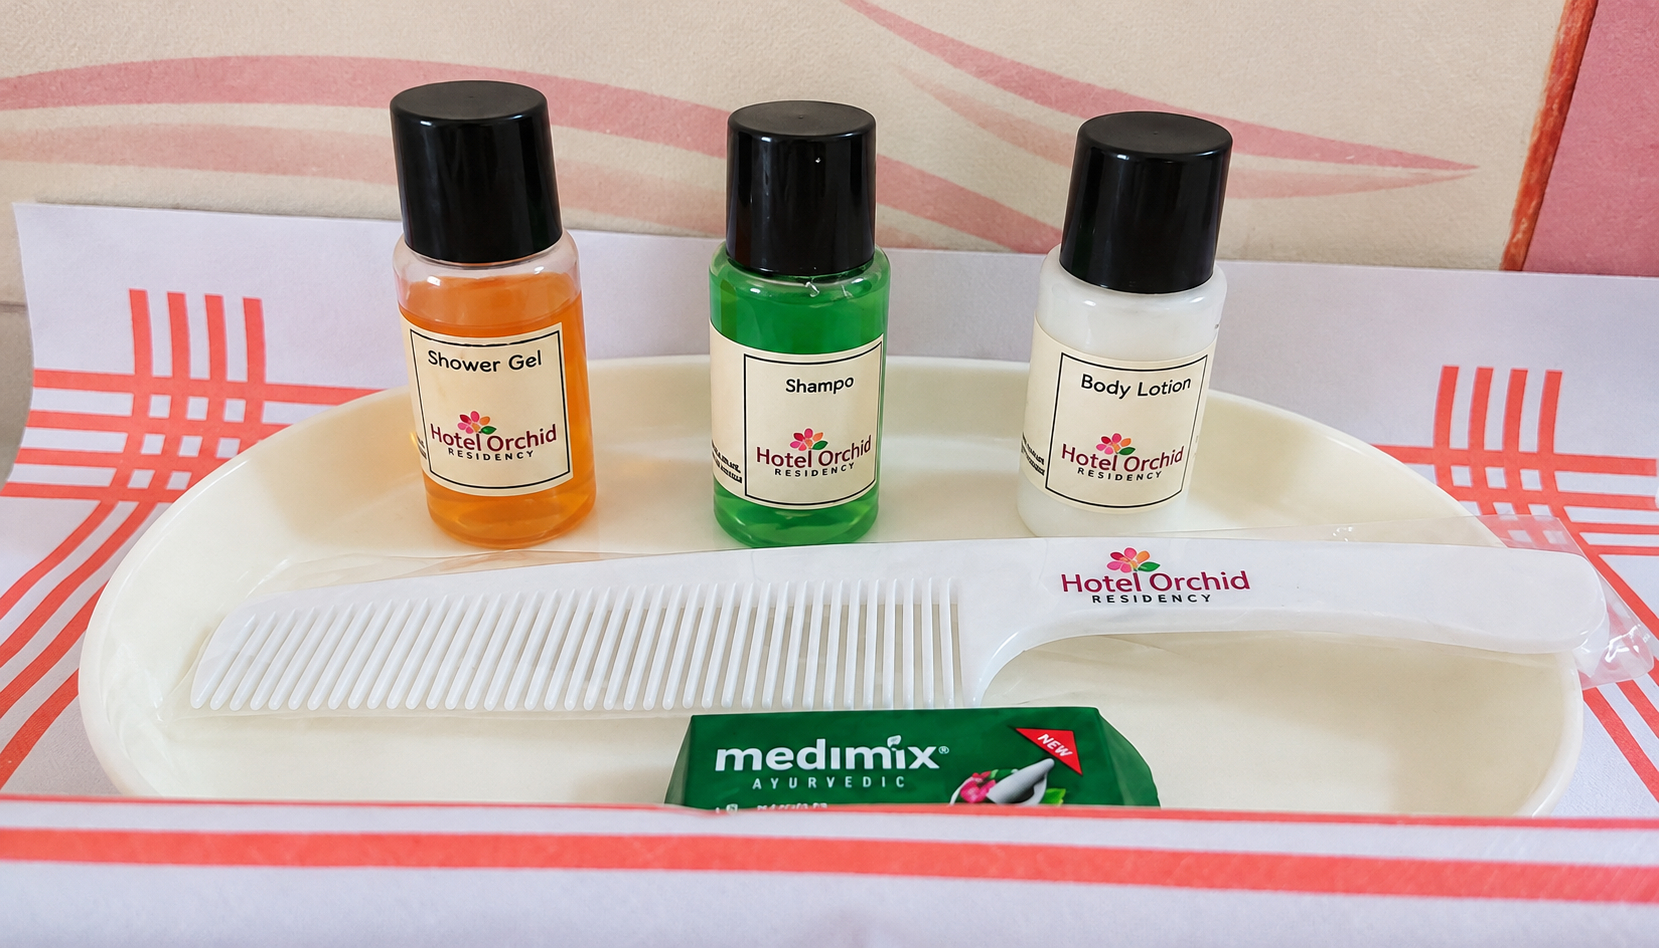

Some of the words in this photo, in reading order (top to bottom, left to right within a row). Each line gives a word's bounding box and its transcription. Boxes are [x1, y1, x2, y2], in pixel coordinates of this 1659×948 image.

[428, 350, 500, 372] Shower
[508, 350, 542, 370] Gel
[785, 377, 854, 394] Shampo
[1081, 374, 1131, 399] Body
[1137, 378, 1191, 397] Lotion
[430, 423, 482, 451] Hotel
[487, 424, 557, 452] Orchid
[448, 447, 534, 461] RESIDENCY
[756, 447, 812, 468] Hotel
[818, 435, 872, 466] Orchid
[1061, 443, 1118, 472] Hotel
[1123, 446, 1184, 472] Orchid
[775, 462, 855, 477] RESIDENCY
[1077, 467, 1162, 482] RESIDENCY
[1061, 572, 1142, 593] Hotel
[1150, 570, 1250, 591] Orchid
[1092, 594, 1211, 604] RESIDENCY
[1037, 733, 1073, 758] NEW
[752, 776, 905, 790] AYURVEDIC
